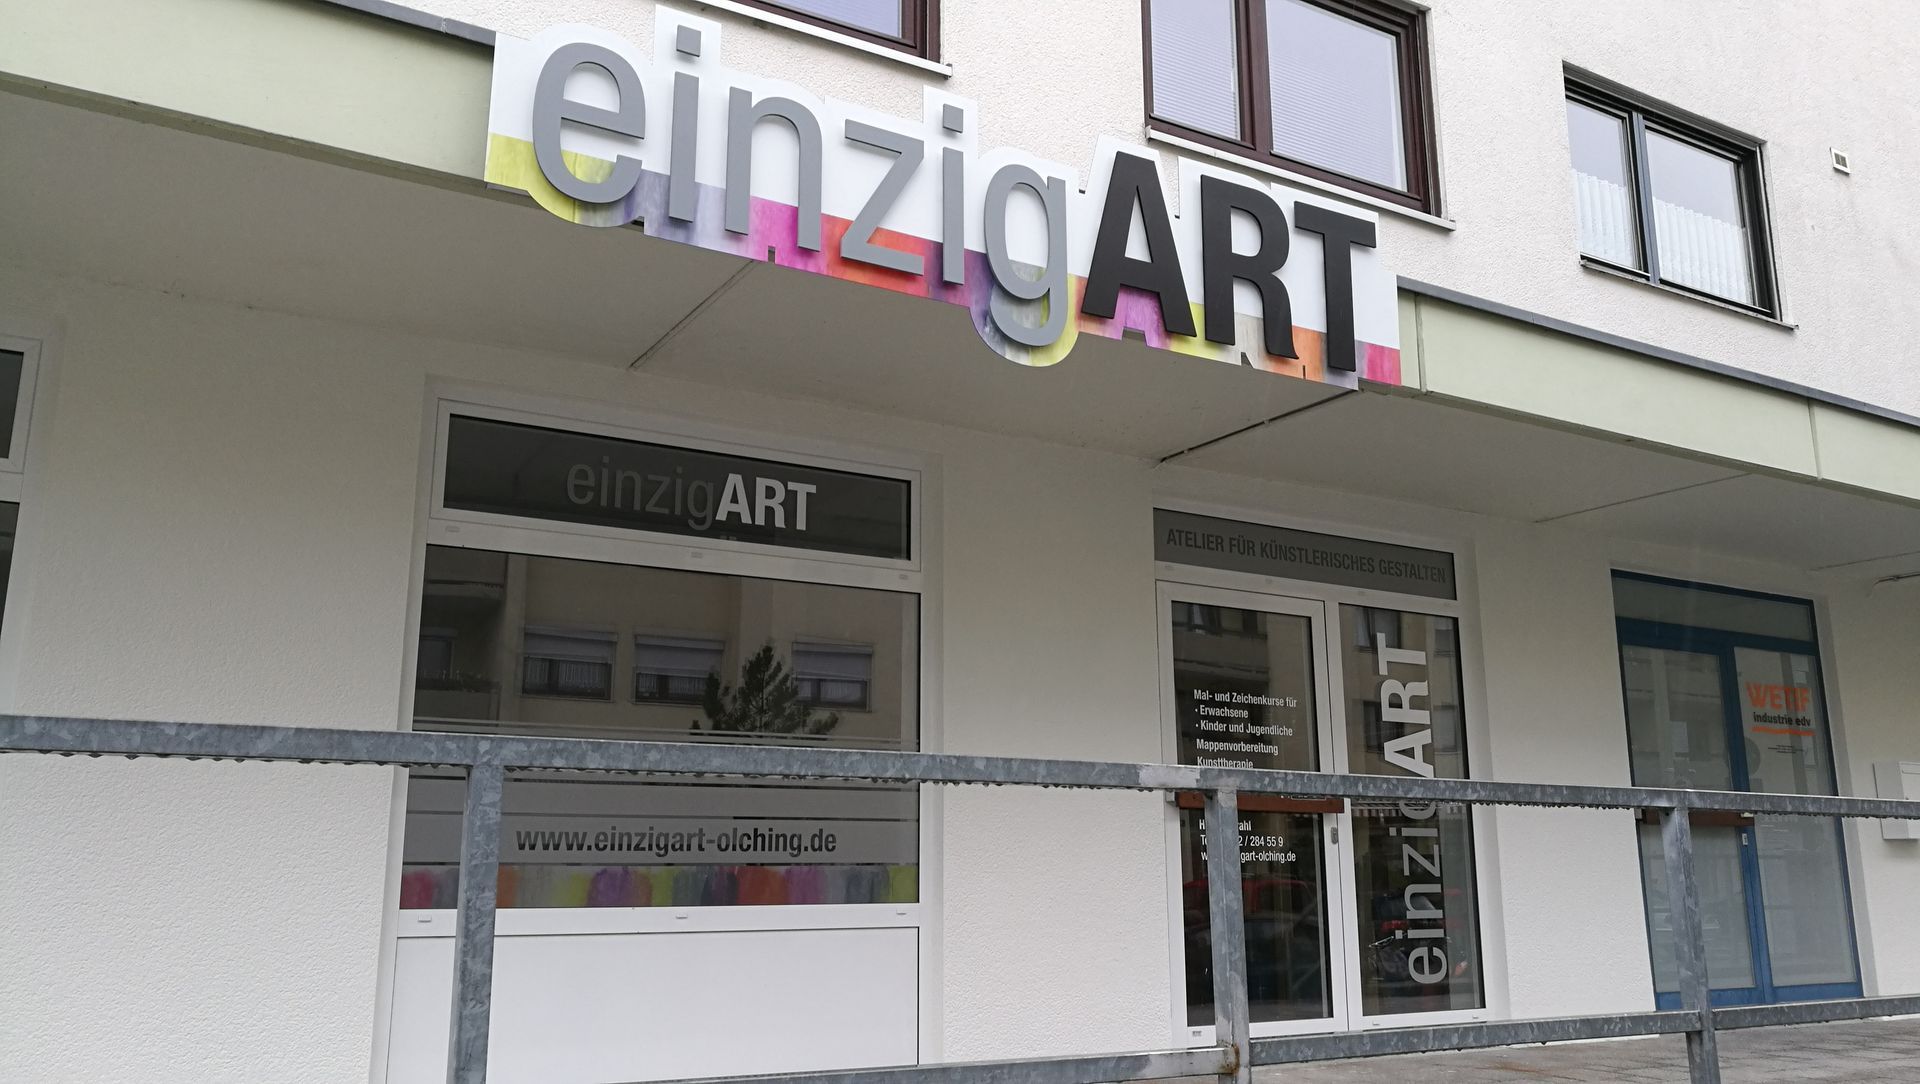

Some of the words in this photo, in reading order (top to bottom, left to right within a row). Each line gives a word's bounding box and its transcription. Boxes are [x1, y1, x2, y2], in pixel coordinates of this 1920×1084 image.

[531, 25, 1377, 373] einzigART
[566, 455, 817, 531] einzigART
[1166, 528, 1225, 552] ATELIER
[1229, 532, 1256, 557] FÜR
[1261, 538, 1375, 573] KÜNSTLERISCHES
[1379, 559, 1447, 584] GESTALTEN
[1194, 689, 1213, 700] Mal-
[1214, 691, 1230, 702] und
[1232, 692, 1284, 706] Zeichenkurse
[1286, 697, 1297, 708] für
[1200, 704, 1249, 718] Erwachsene
[1753, 712, 1793, 725] industrie
[1795, 716, 1811, 727] edv
[1200, 720, 1227, 732] Kinder
[1229, 723, 1244, 733] und
[1246, 723, 1293, 736] Jugendliche
[1196, 738, 1279, 756] Mappenvorbereitung
[516, 826, 837, 858] www.einzigart-olching.de
[1250, 836, 1265, 847] 284
[1266, 836, 1277, 847] 55
[1278, 836, 1284, 847] 9
